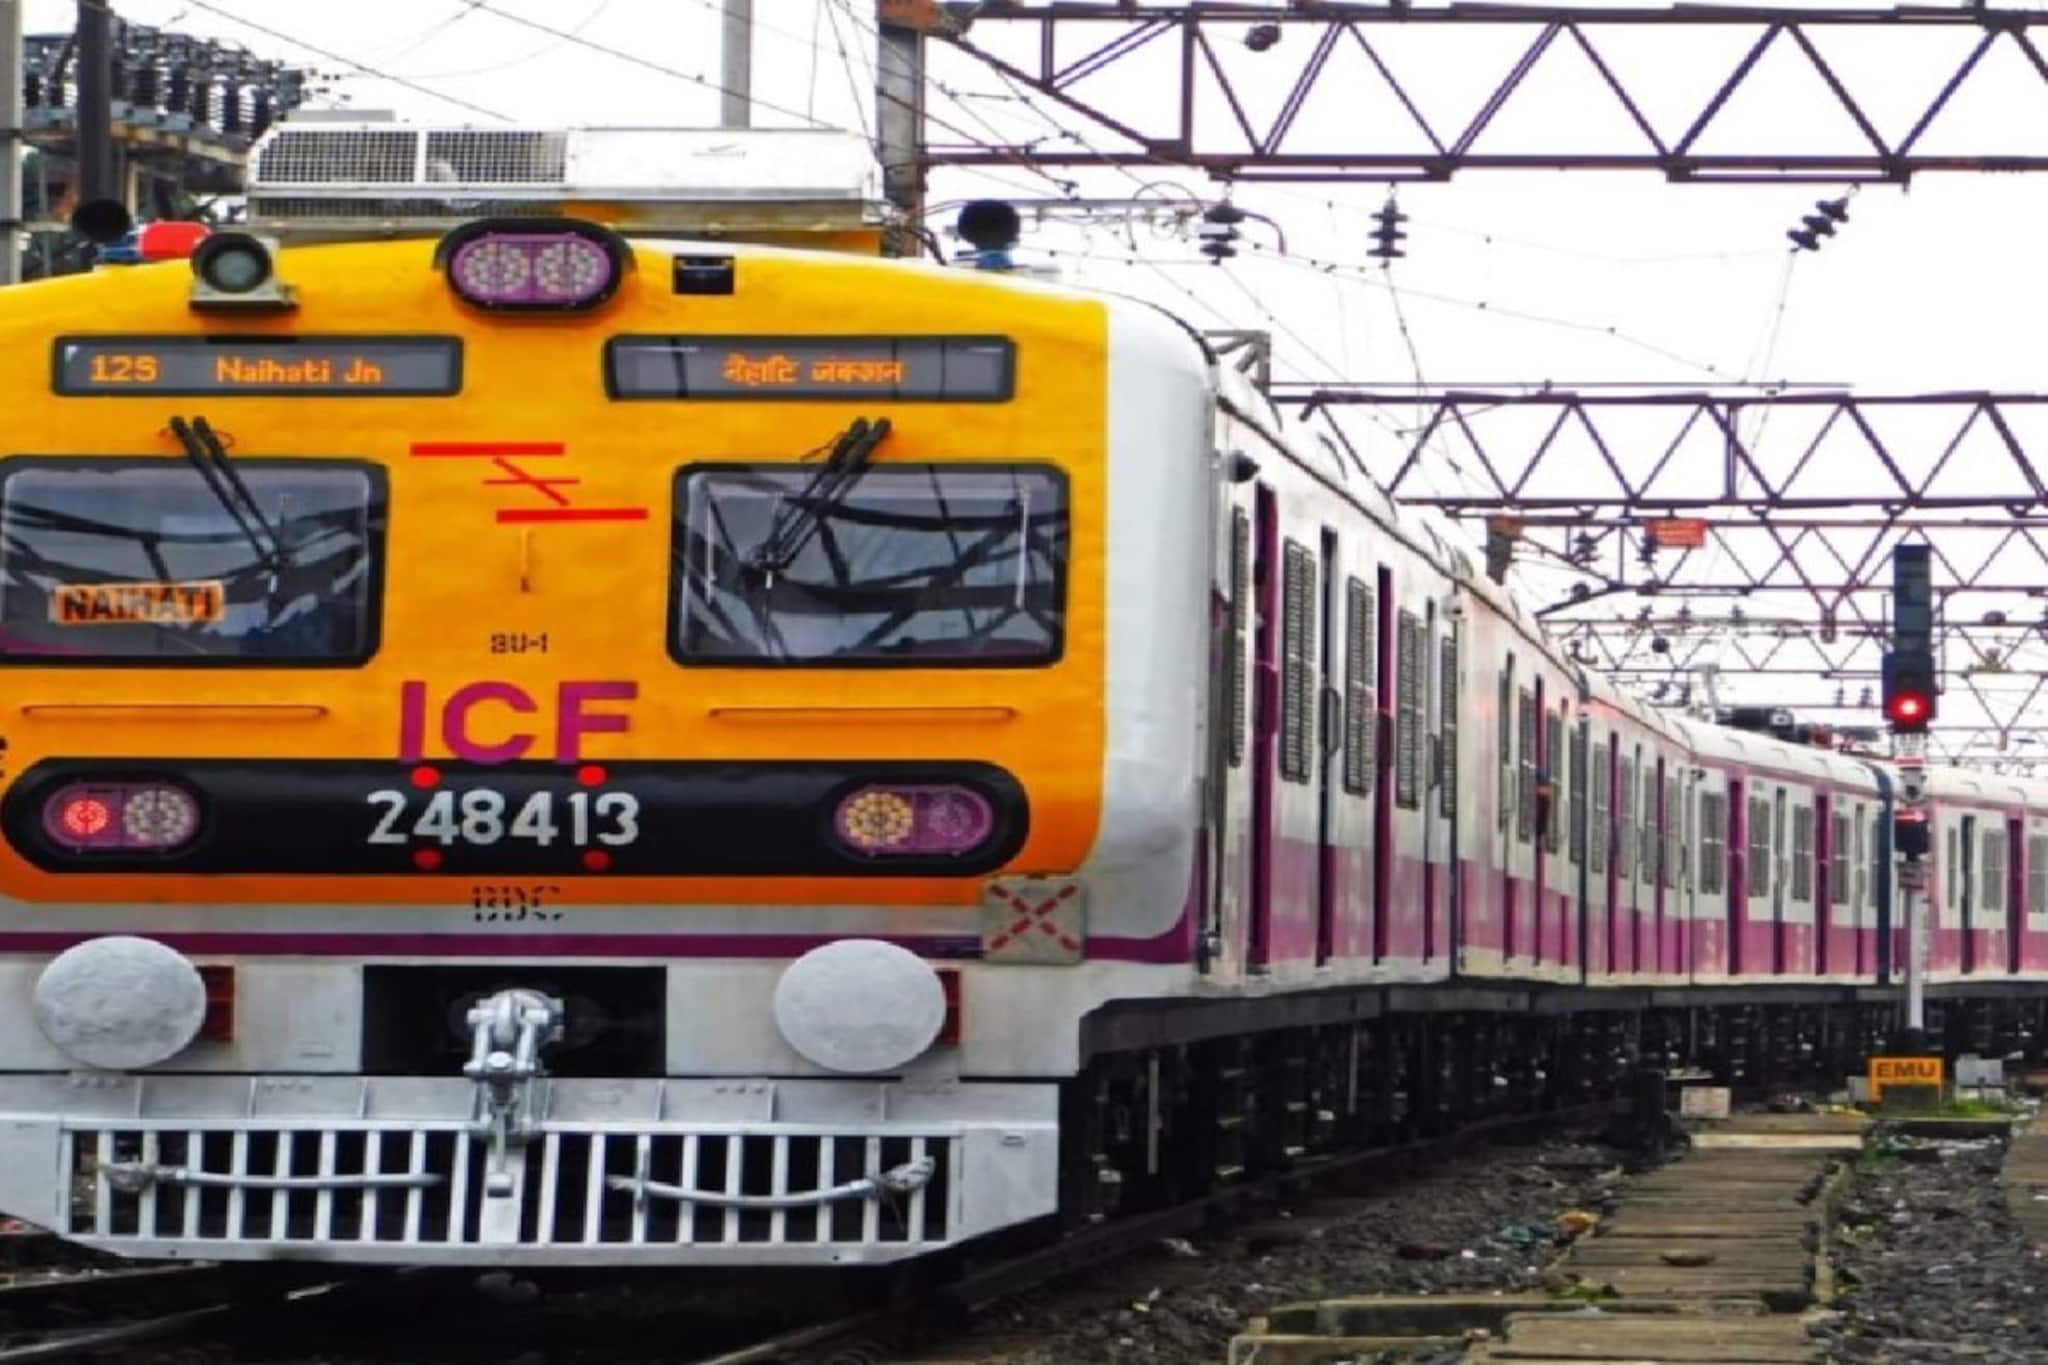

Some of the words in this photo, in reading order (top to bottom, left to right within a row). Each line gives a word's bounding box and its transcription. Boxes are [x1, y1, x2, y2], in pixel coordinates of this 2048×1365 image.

[215, 354, 332, 384] Naihati
[343, 357, 384, 383] Jn
[400, 680, 638, 765] ICF
[367, 788, 640, 846] 248413
[1876, 1061, 1938, 1078] EMU
